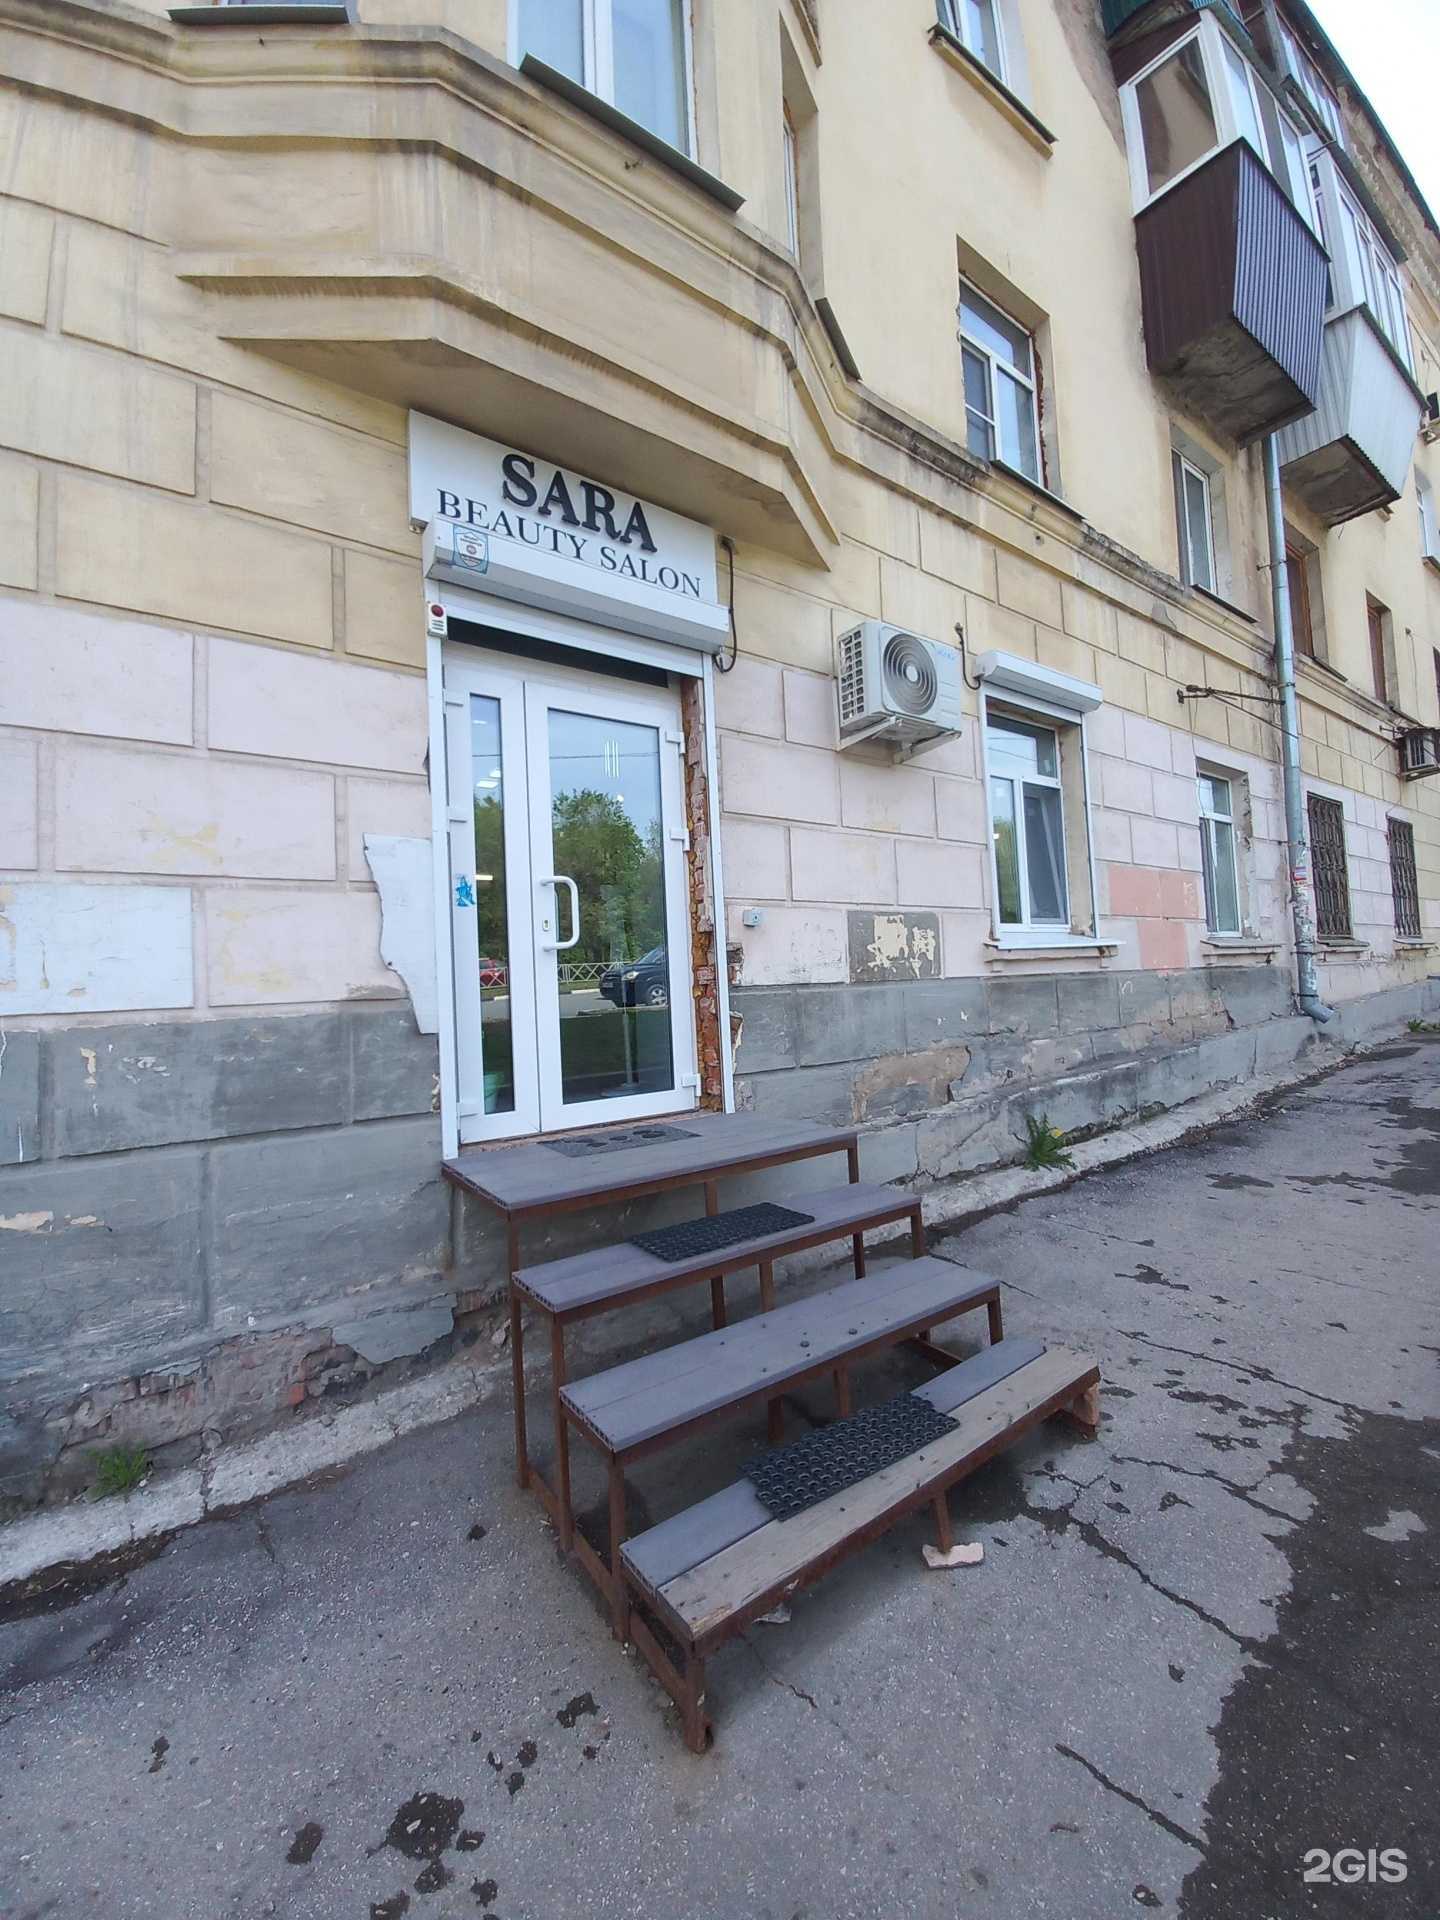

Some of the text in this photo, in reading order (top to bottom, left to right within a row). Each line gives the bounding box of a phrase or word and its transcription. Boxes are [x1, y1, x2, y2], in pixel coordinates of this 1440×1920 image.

[437, 488, 702, 598] BEAUTY SALON
[502, 453, 658, 553] SARA
